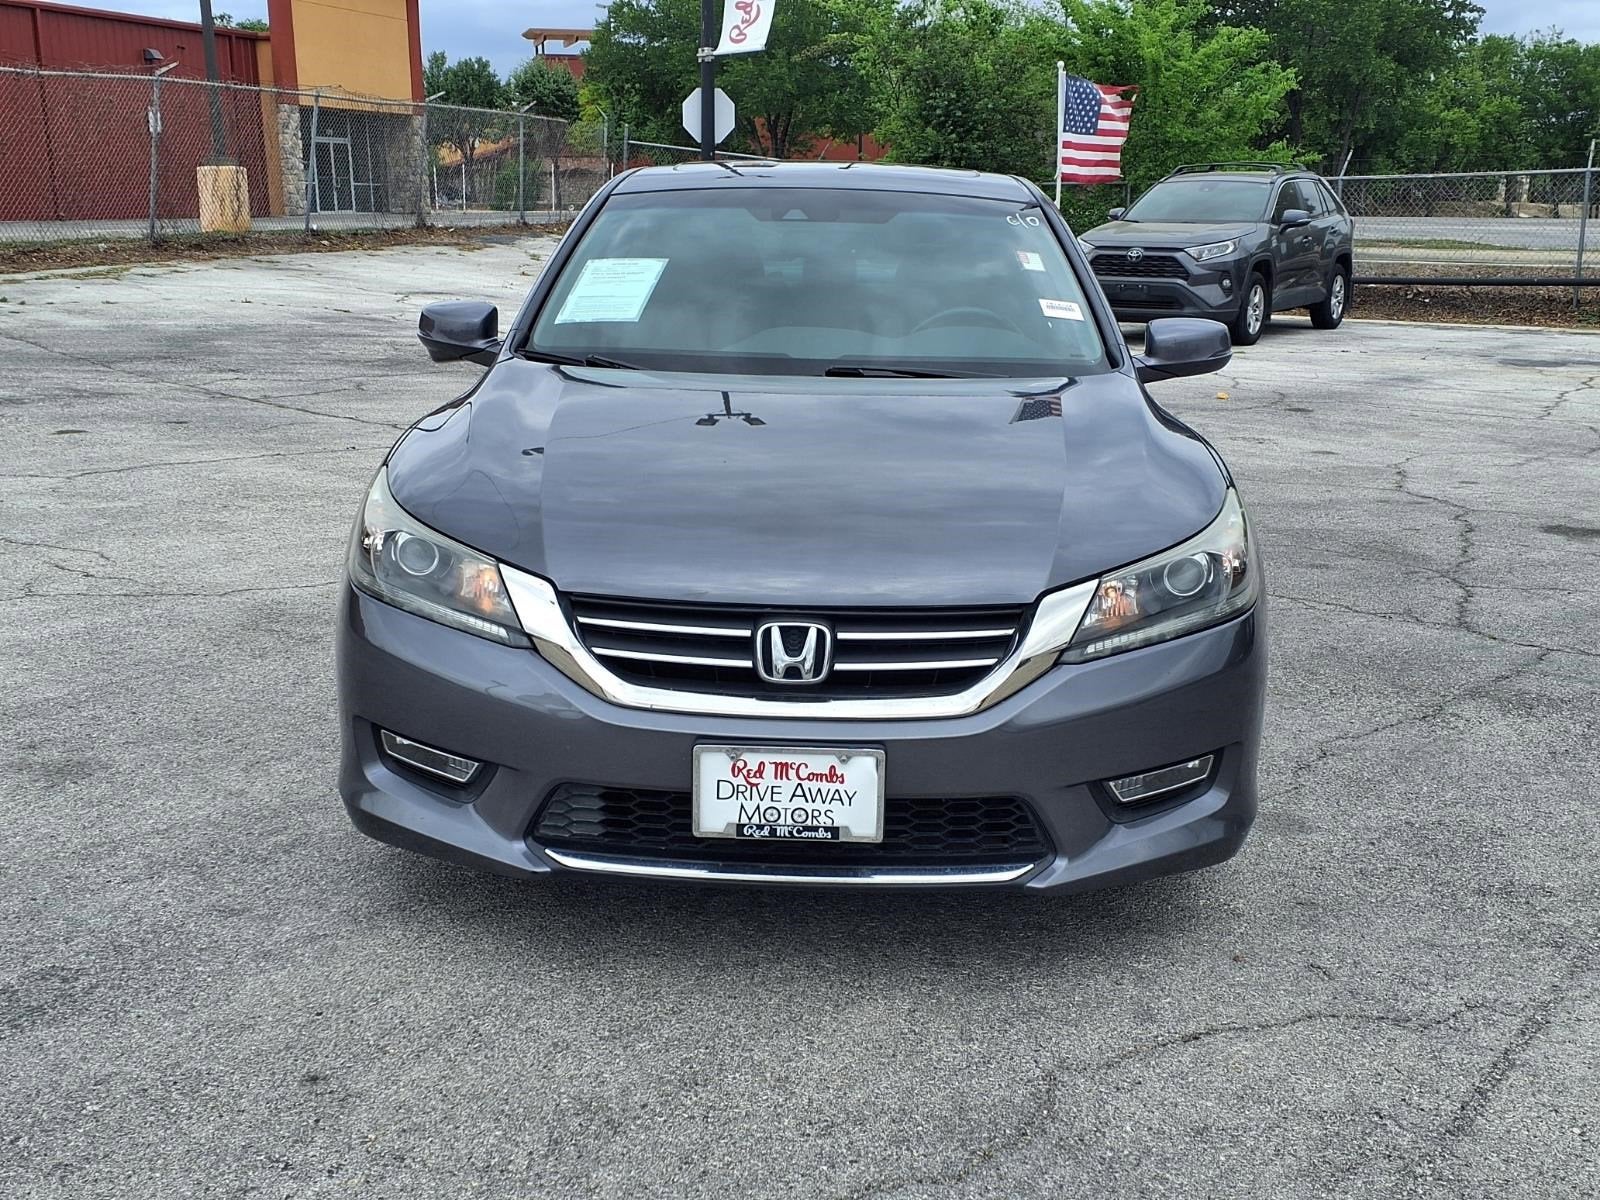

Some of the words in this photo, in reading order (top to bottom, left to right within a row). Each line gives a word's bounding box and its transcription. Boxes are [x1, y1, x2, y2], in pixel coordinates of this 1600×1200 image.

[729, 0, 761, 44] Red
[731, 758, 766, 788] Red
[769, 761, 845, 784] McCombs
[716, 779, 782, 803] DRIVE
[789, 782, 858, 807] AWAY
[738, 802, 835, 826] MOTORS
[743, 825, 770, 838] Red
[772, 825, 832, 839] McCombs
